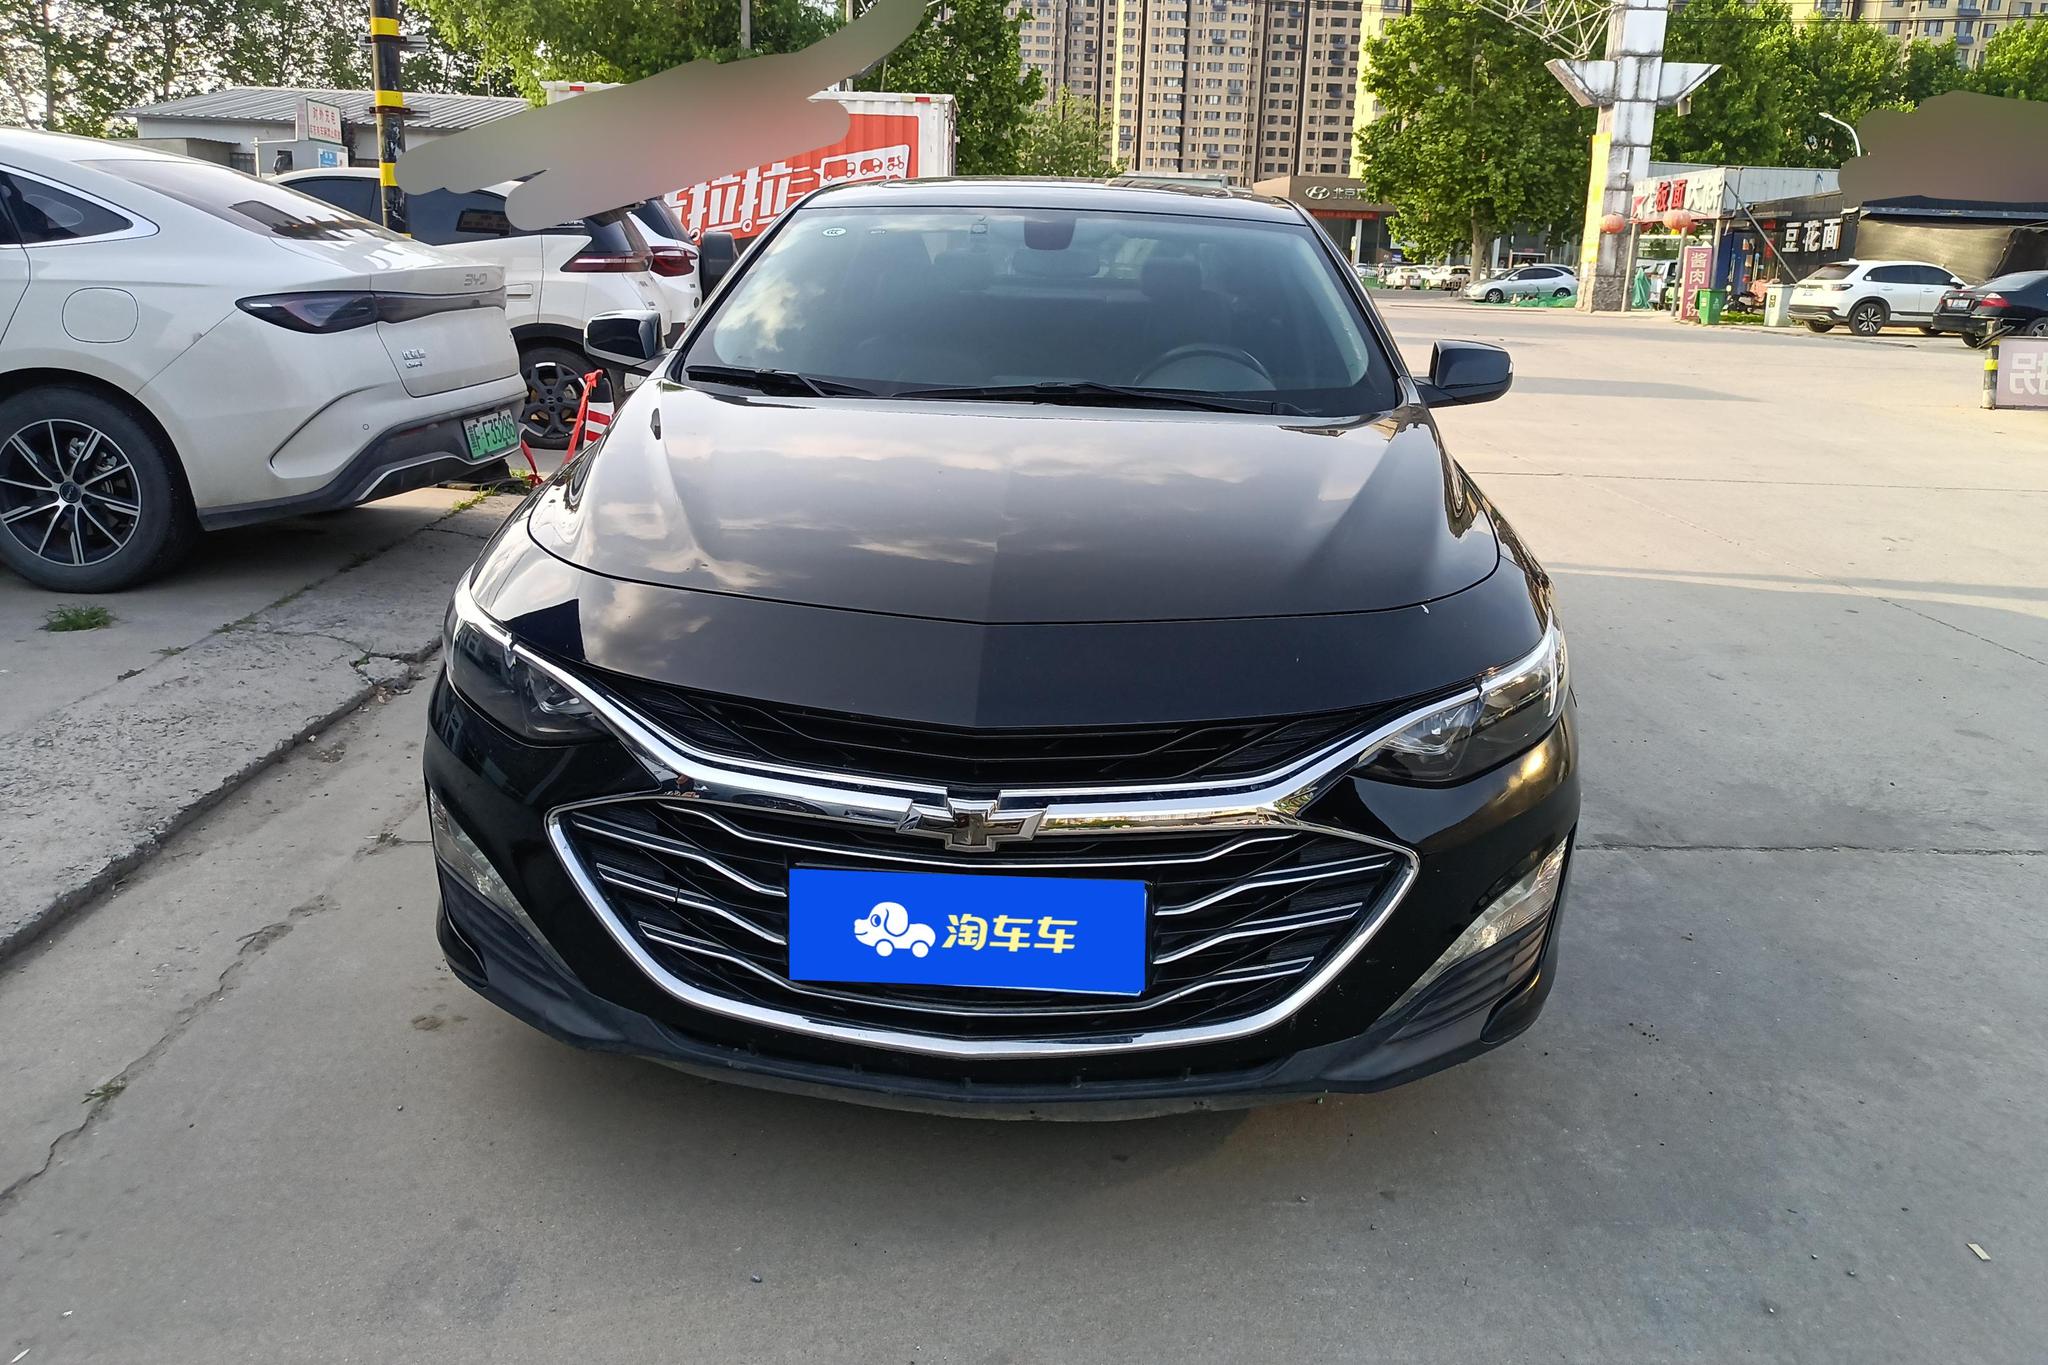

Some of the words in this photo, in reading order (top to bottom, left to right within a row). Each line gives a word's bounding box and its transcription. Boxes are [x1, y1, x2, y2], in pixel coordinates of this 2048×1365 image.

[1781, 218, 1843, 253] 豆花面
[464, 273, 488, 287] BYD
